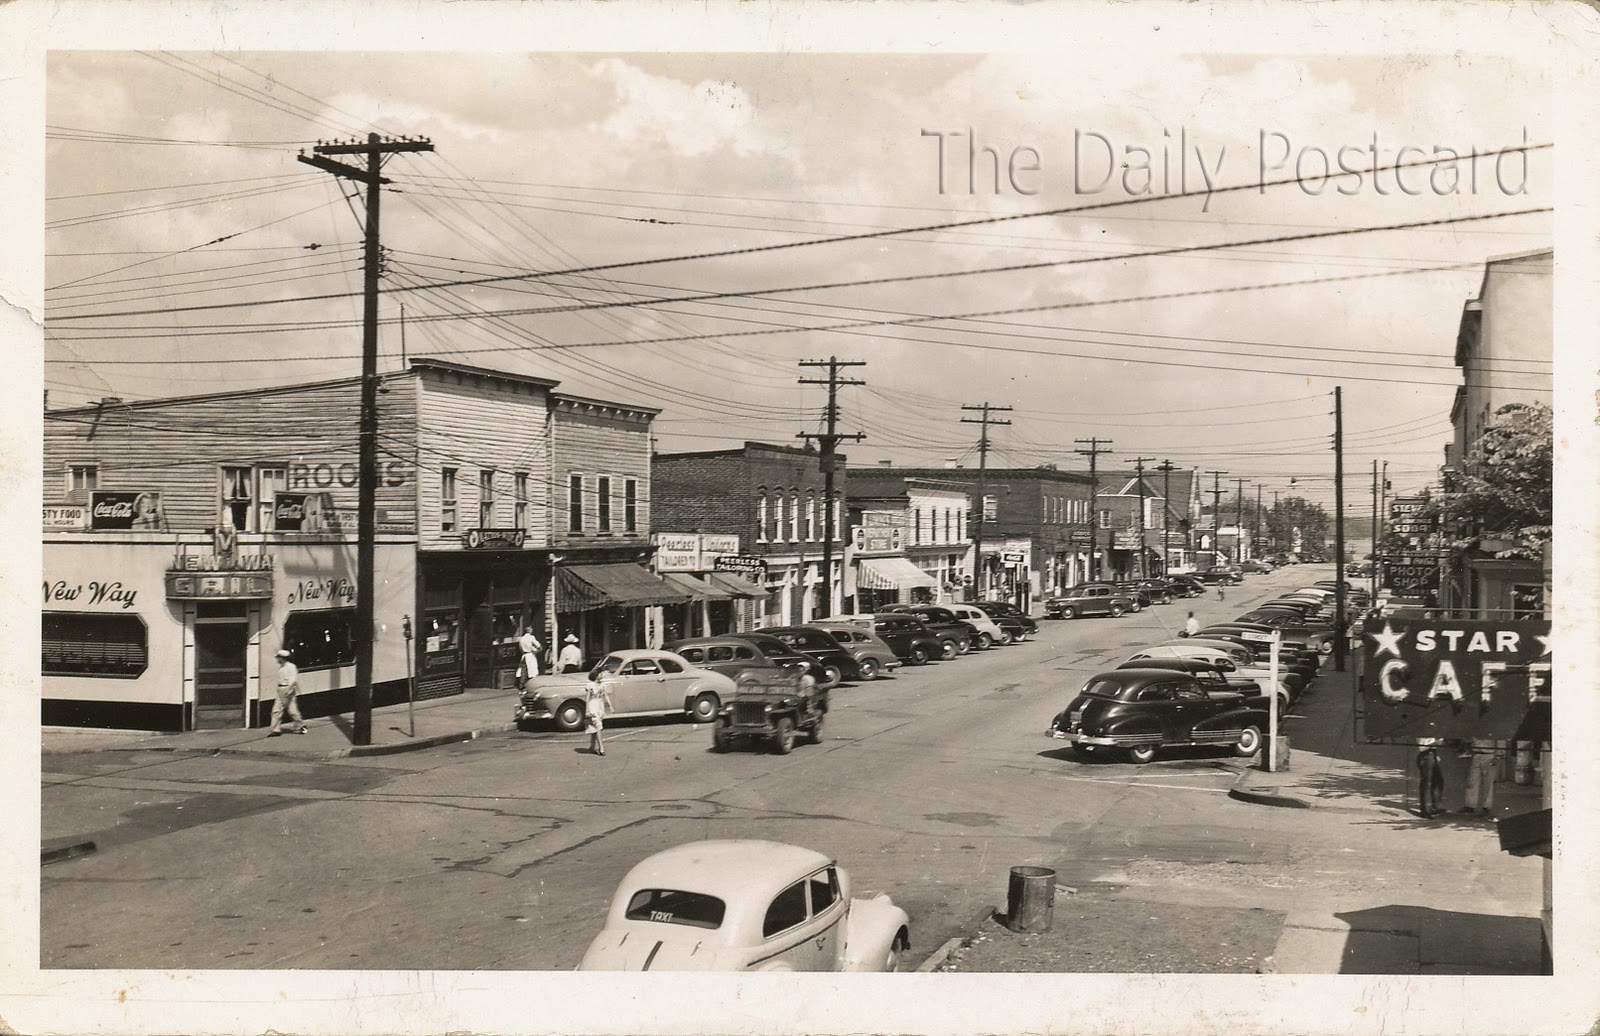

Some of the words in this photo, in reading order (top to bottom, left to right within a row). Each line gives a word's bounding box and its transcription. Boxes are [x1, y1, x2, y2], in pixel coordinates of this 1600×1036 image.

[293, 462, 407, 489] ROOS
[61, 509, 81, 519] FOOD
[173, 555, 221, 571] NEW
[720, 557, 760, 566] PEERLESS
[1390, 567, 1432, 576] PHOTO
[1393, 577, 1428, 586] SHOP
[89, 582, 138, 609] Way
[288, 580, 324, 604] New
[326, 578, 355, 603] Way
[1415, 630, 1520, 652] STAR
[650, 910, 674, 922] TAXI
